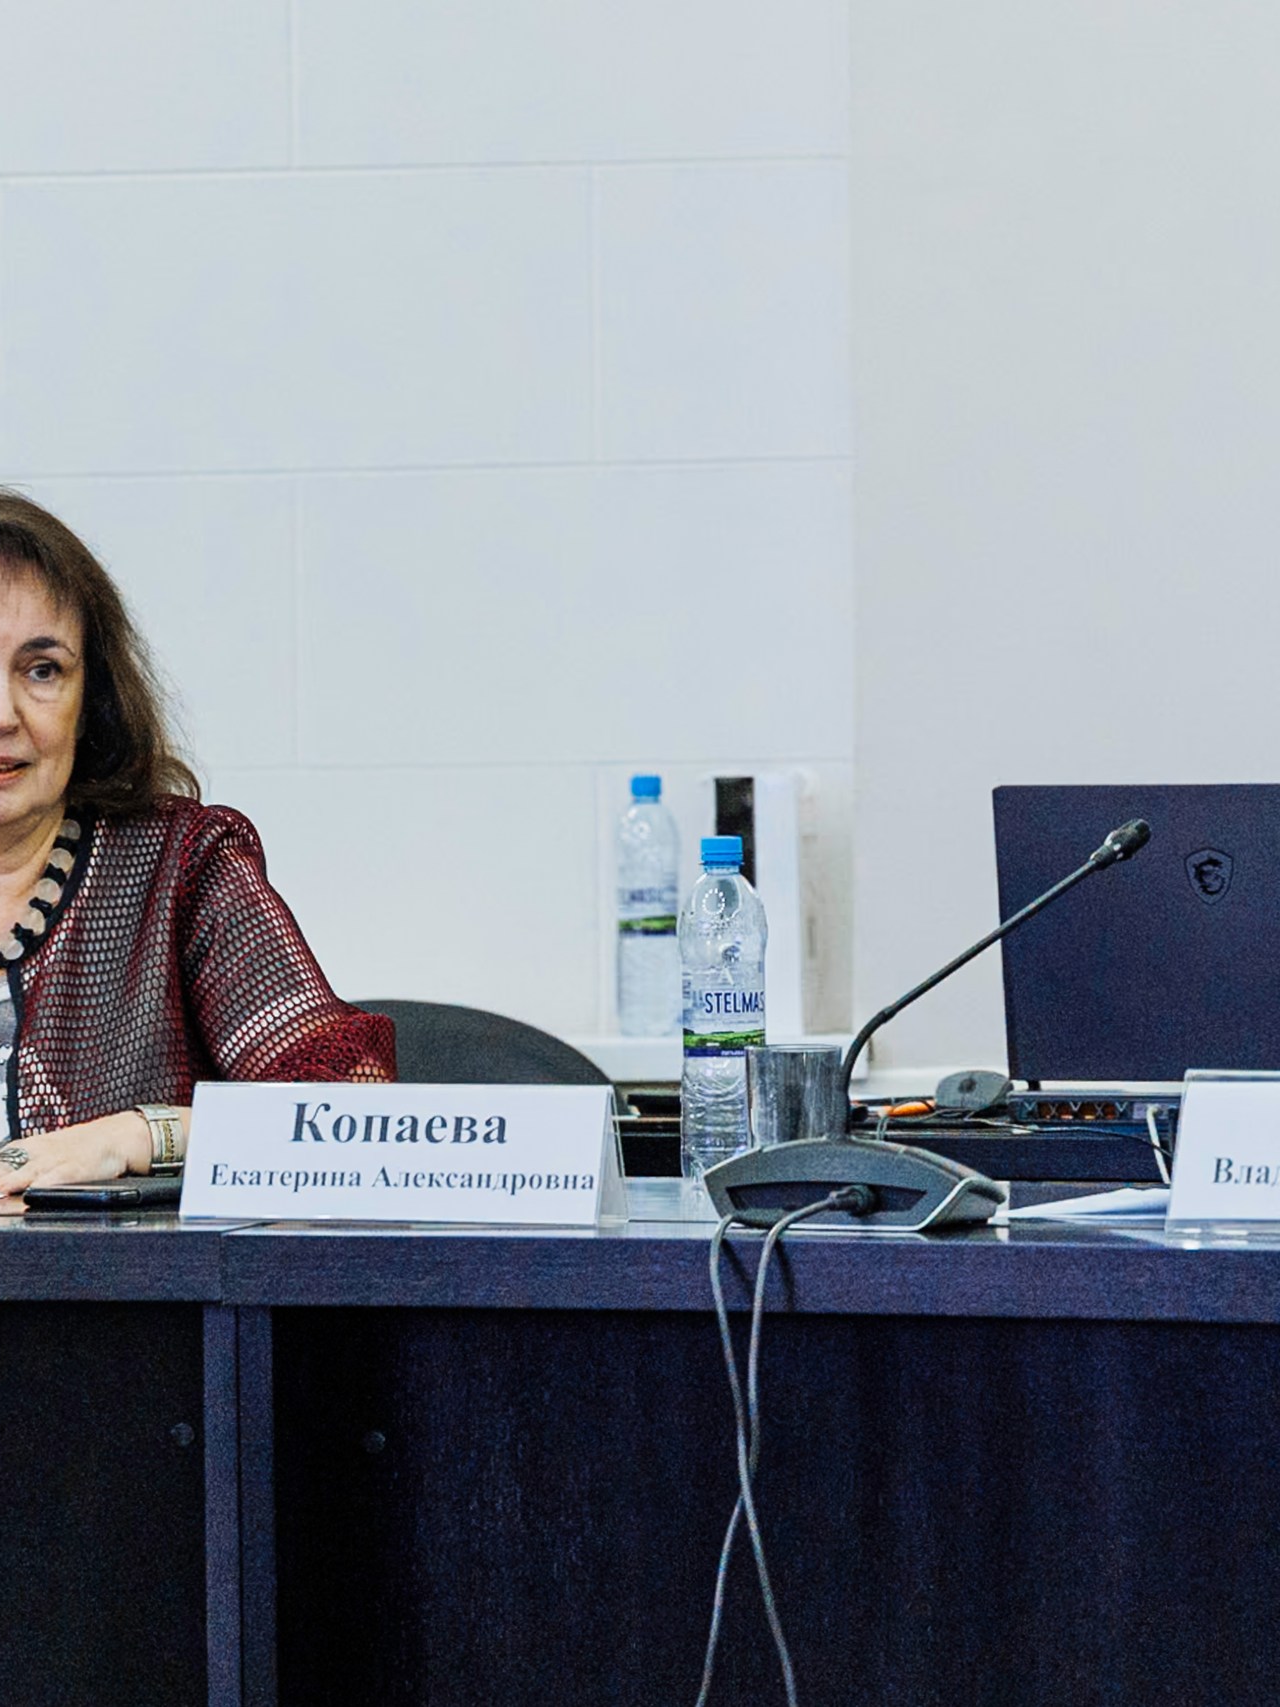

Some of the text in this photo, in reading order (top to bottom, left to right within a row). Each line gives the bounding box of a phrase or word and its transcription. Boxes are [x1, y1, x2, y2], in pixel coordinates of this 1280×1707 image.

[289, 1102, 508, 1145] Копаева
[209, 1163, 595, 1196] Екатерина Александровна
